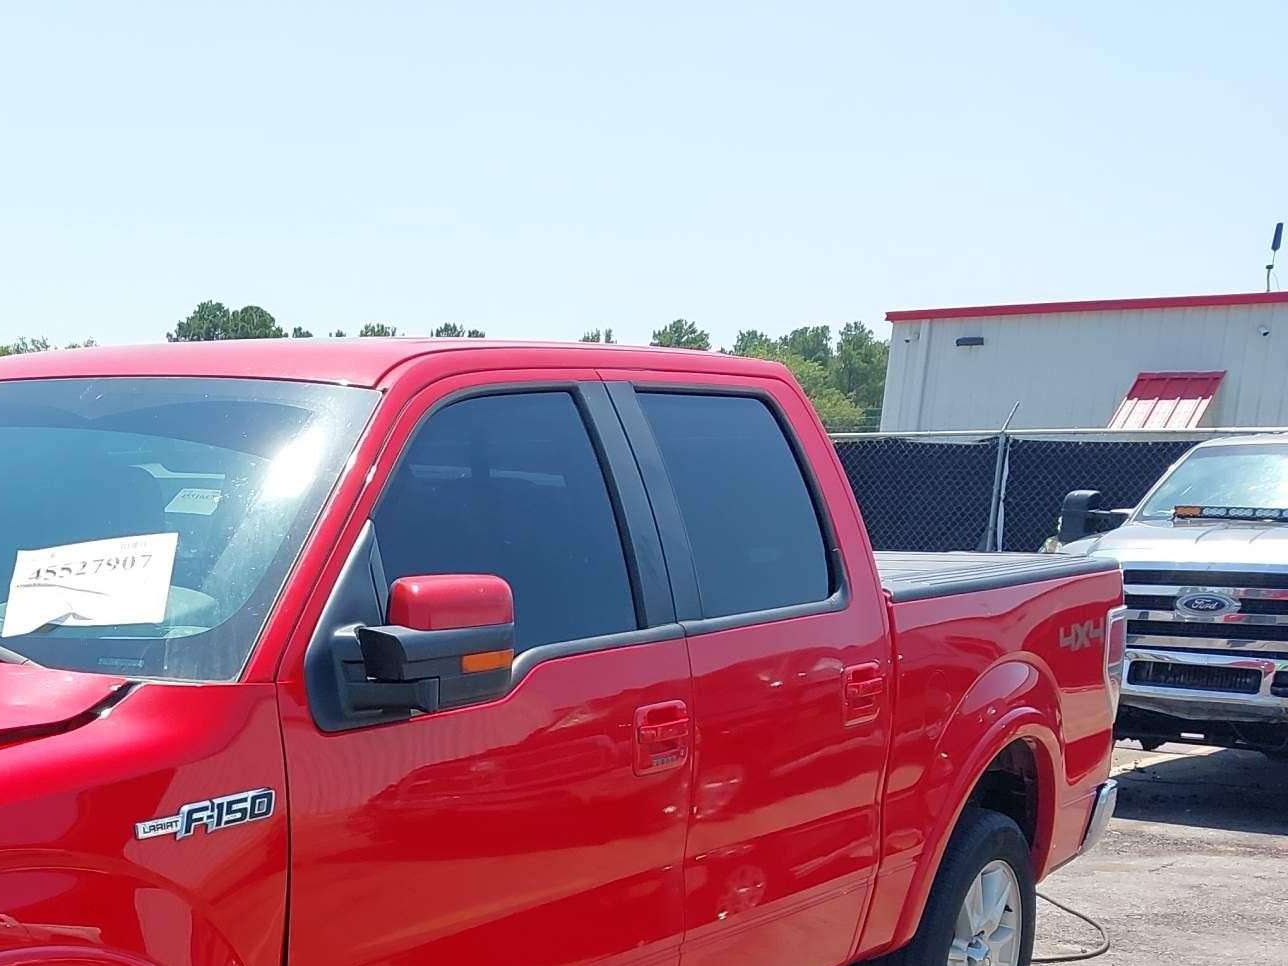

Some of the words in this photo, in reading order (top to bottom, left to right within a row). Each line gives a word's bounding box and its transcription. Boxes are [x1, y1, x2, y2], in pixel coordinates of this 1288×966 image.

[27, 554, 153, 581] 45527907
[1191, 598, 1219, 610] Ford
[142, 819, 180, 835] LARIAT
[178, 788, 276, 839] F-150
